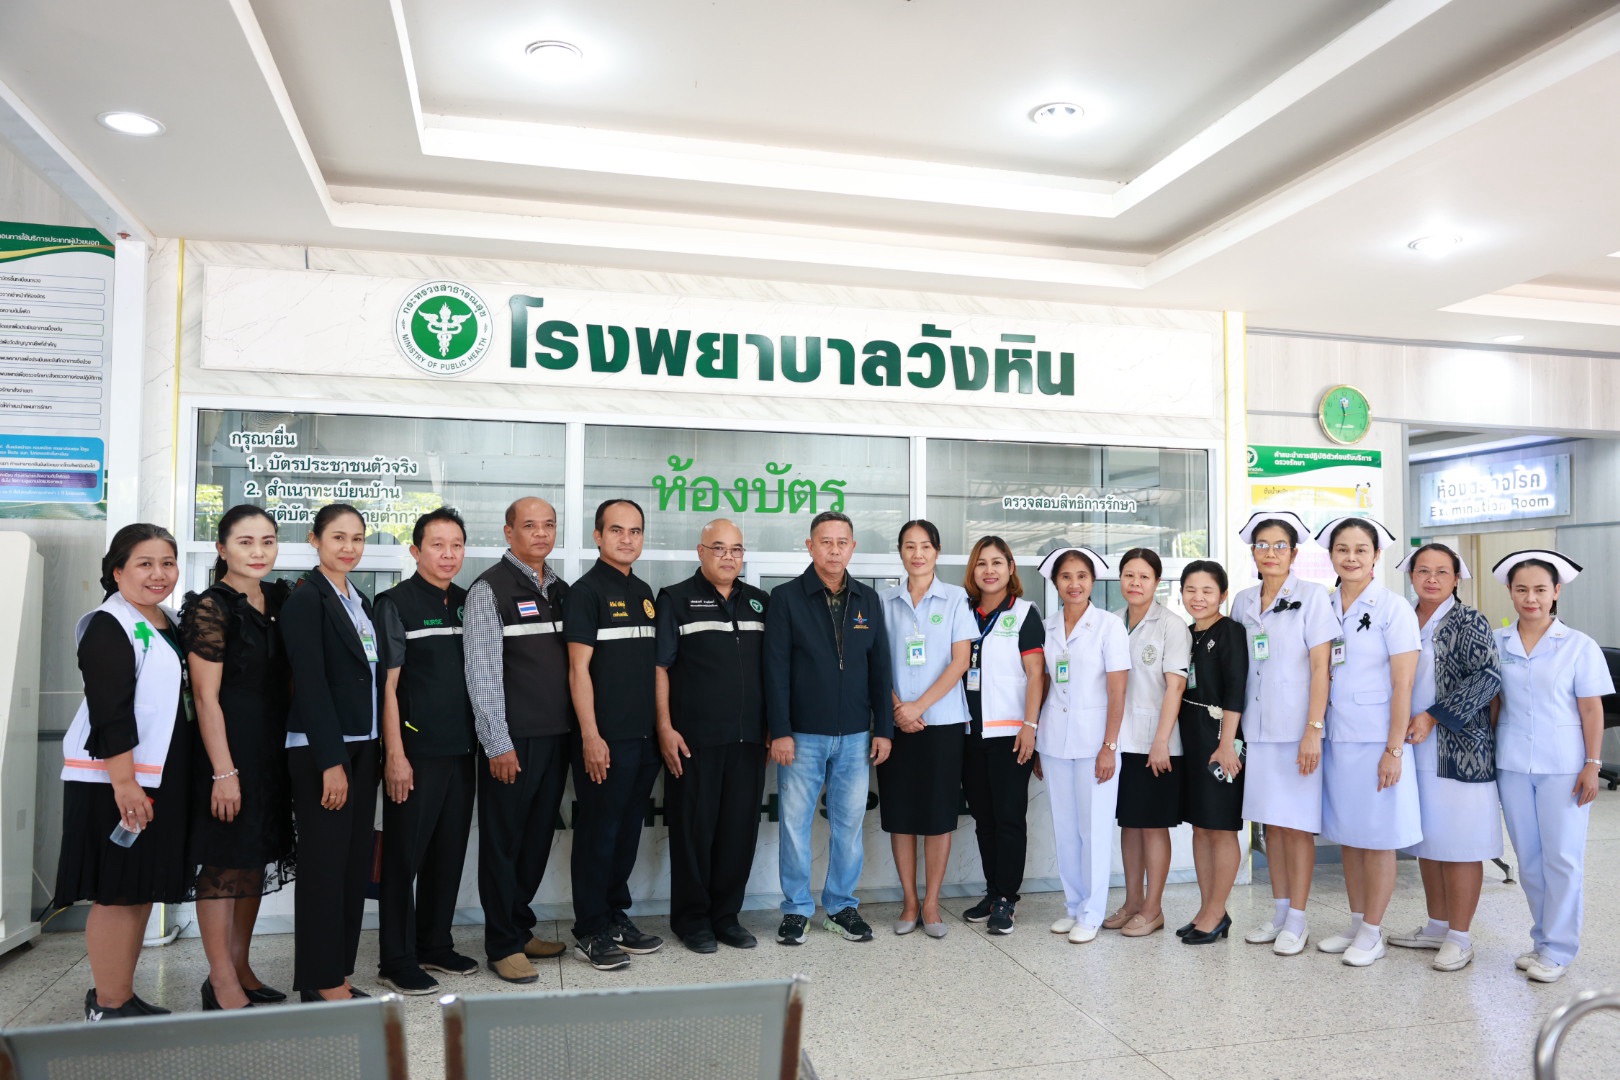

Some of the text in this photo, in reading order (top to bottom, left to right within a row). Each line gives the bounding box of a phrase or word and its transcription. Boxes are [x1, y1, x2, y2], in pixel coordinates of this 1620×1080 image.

[403, 284, 487, 318] กระทรวงสาธารณสุข
[402, 333, 488, 371] MINISTRY OF PUBLIC HEALTH
[508, 294, 1075, 396] โรงพยาบาลวังหิน
[231, 426, 296, 449] กรุณายื่น
[248, 454, 418, 474] 1. บัตรประชาชนตัวจริง
[246, 479, 400, 499] 2. สำเนาทะเบียนบ้าน
[651, 454, 848, 515] ห้องบัตร
[1003, 494, 1137, 511] ตรวจสอบสิทธิการรักษา
[423, 618, 443, 626] NURSE
